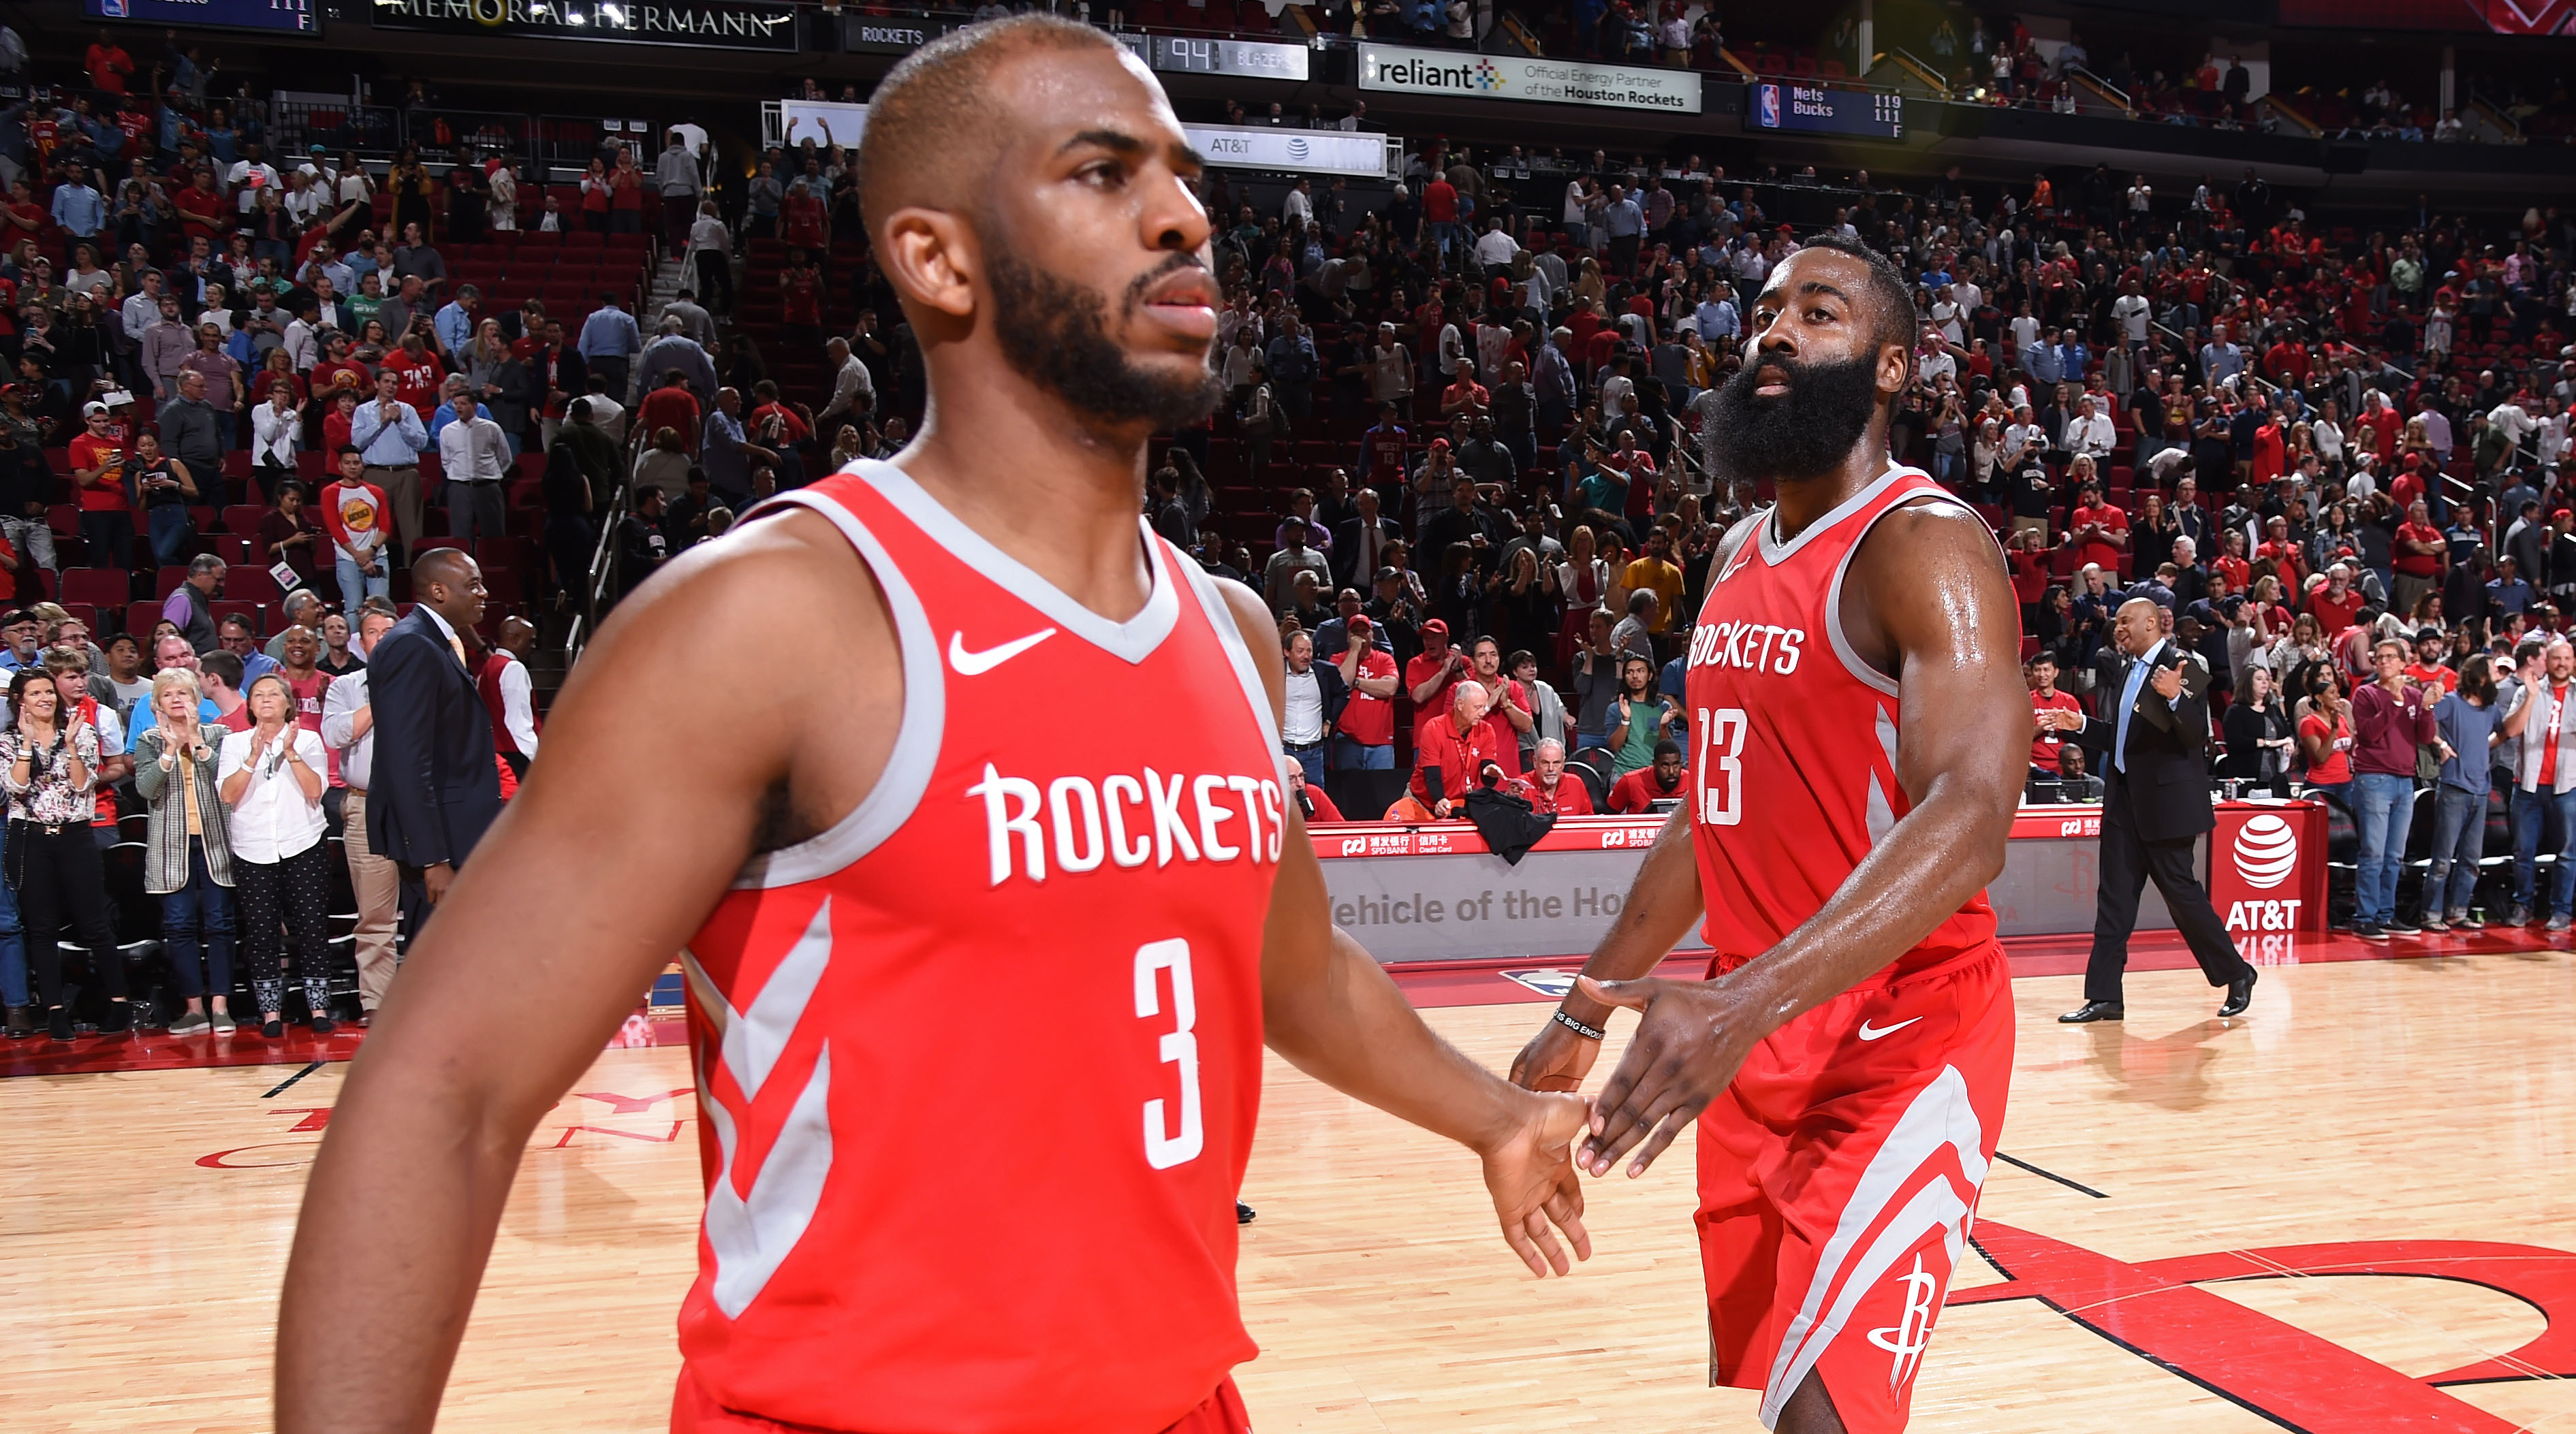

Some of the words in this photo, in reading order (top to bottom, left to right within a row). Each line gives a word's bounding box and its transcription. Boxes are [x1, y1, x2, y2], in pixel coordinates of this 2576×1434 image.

[297, 14, 311, 29] F
[390, 0, 584, 26] MEMORIAL
[593, 3, 772, 37] HERMANN
[862, 27, 923, 45] ROCKETS
[1172, 39, 1210, 69] 94
[1379, 59, 1474, 89] reliant
[1524, 65, 1567, 80] Official
[1571, 69, 1614, 86] Energy
[1616, 73, 1662, 88] Partner
[1524, 83, 1539, 95] of
[1540, 84, 1562, 97] the
[1565, 85, 1624, 102] Houston
[1629, 91, 1684, 107] Rockets
[1793, 86, 1824, 102] Nets
[1874, 94, 1901, 109] 119
[1793, 101, 1834, 117] Bucks
[1874, 108, 1900, 123] 111
[1893, 124, 1902, 138] F
[1210, 138, 1251, 153] AT&T
[1687, 619, 1805, 675] ROCKETS
[1697, 707, 1748, 825] 13
[966, 761, 1283, 887] ROCKETS
[1419, 835, 1448, 846] 信用卡
[1456, 890, 1492, 921] of
[1503, 889, 1562, 920] the
[2225, 899, 2302, 931] AT&T
[1557, 1012, 1565, 1021] IS
[1564, 1017, 1580, 1030] BIG
[1133, 937, 1204, 1170] 3
